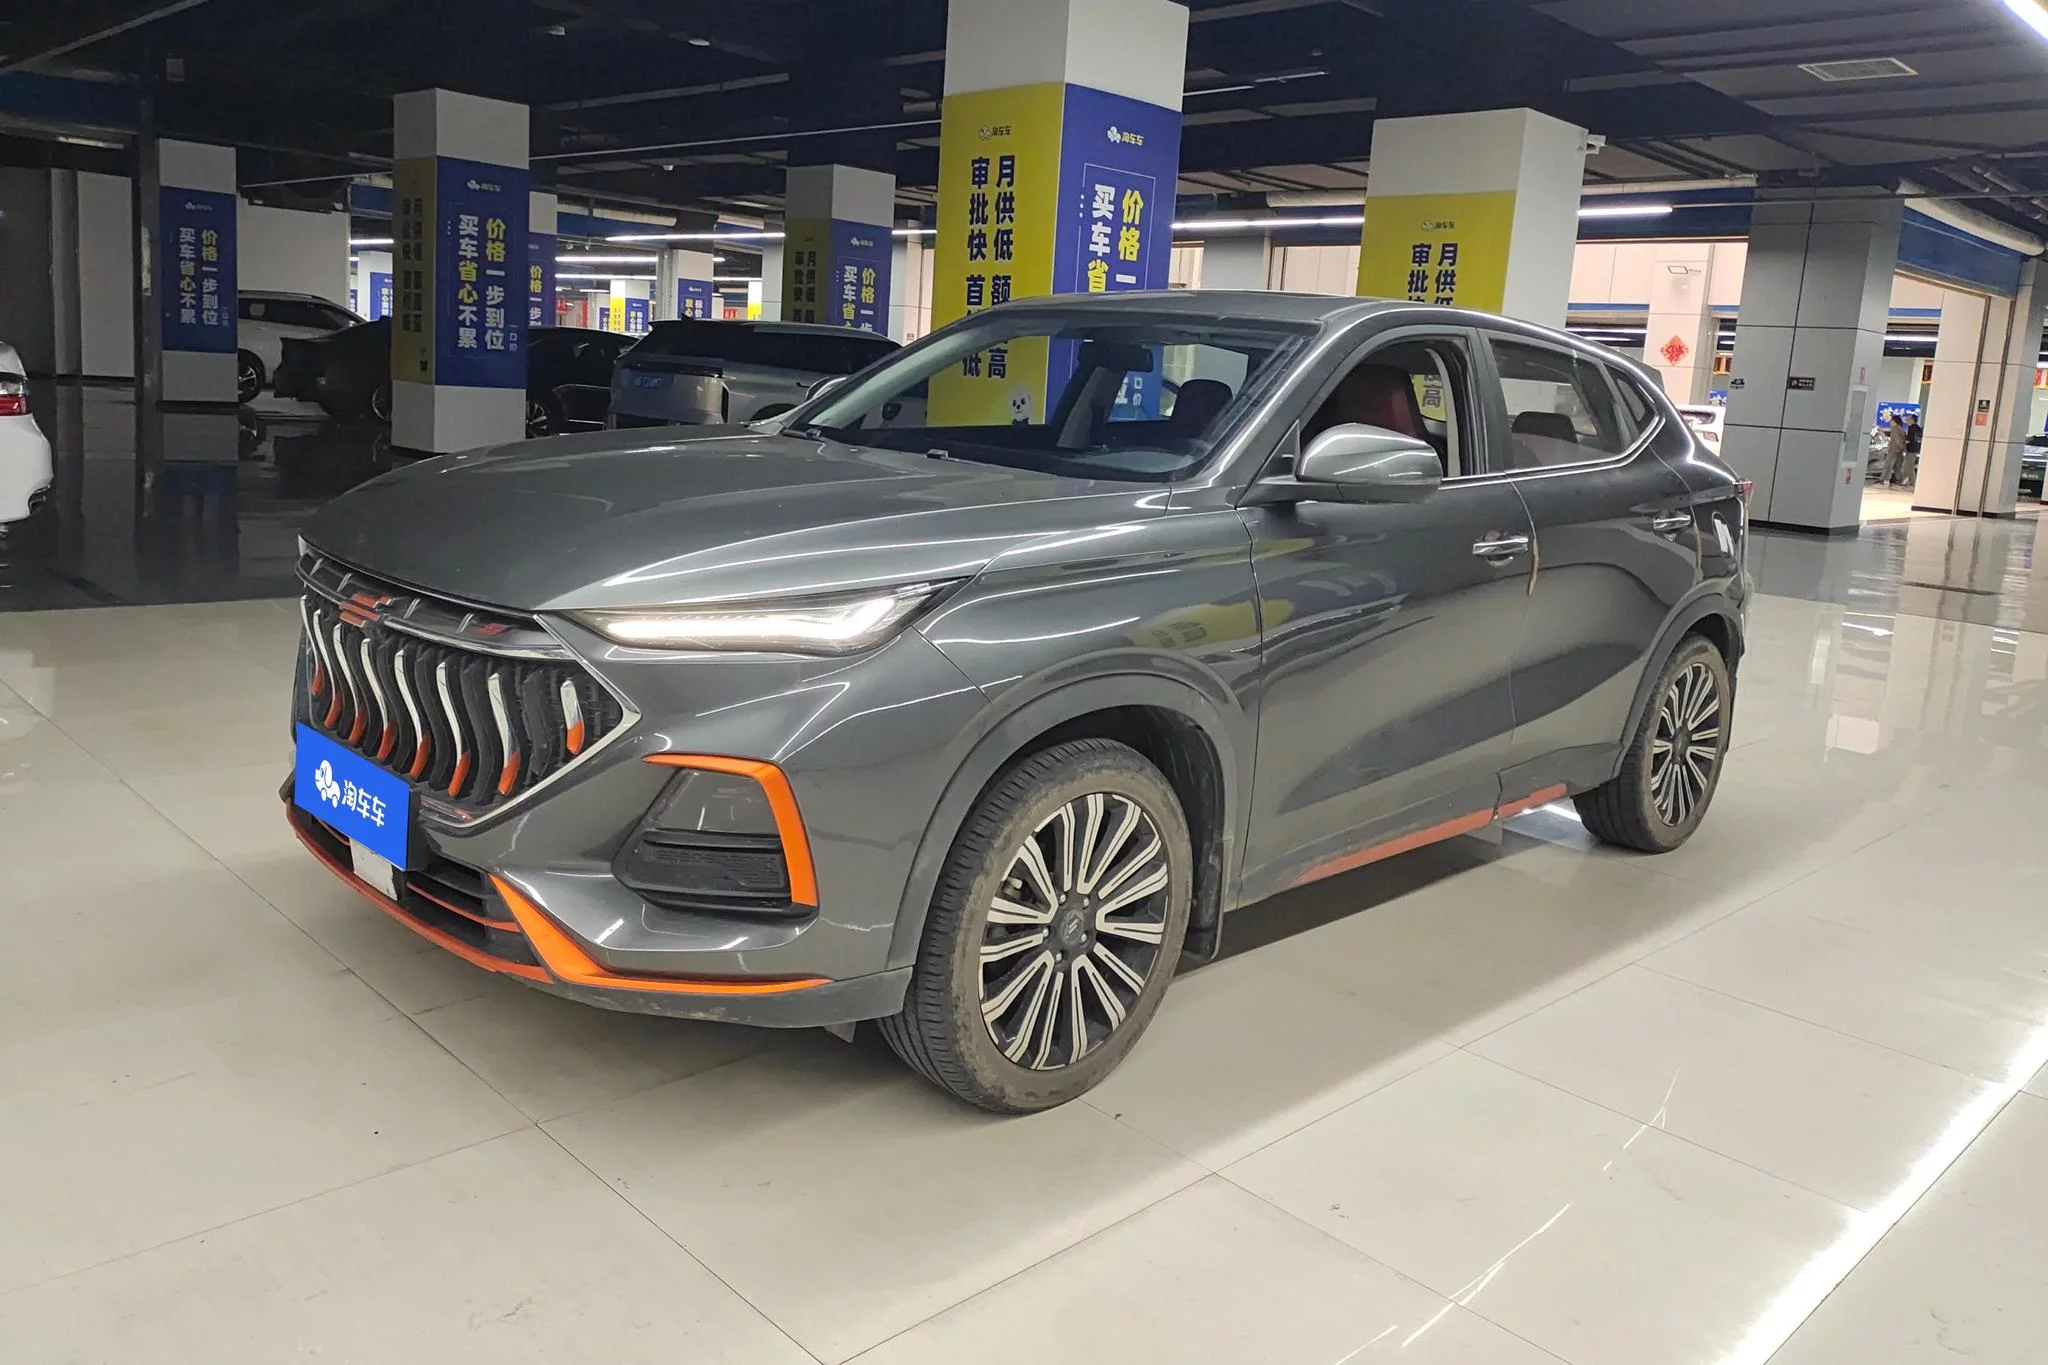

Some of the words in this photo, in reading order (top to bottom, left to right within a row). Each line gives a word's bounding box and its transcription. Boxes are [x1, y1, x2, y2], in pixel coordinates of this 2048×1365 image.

[967, 156, 990, 261] 审批快
[993, 155, 1015, 261] 月供低
[1088, 183, 1116, 293] 买车省
[1115, 188, 1144, 285] 价格一
[179, 227, 197, 325] 买车省心不累
[201, 229, 219, 326] 价格一步到位
[457, 214, 479, 350] 买车省心不累
[485, 217, 506, 351] 价格一步到位
